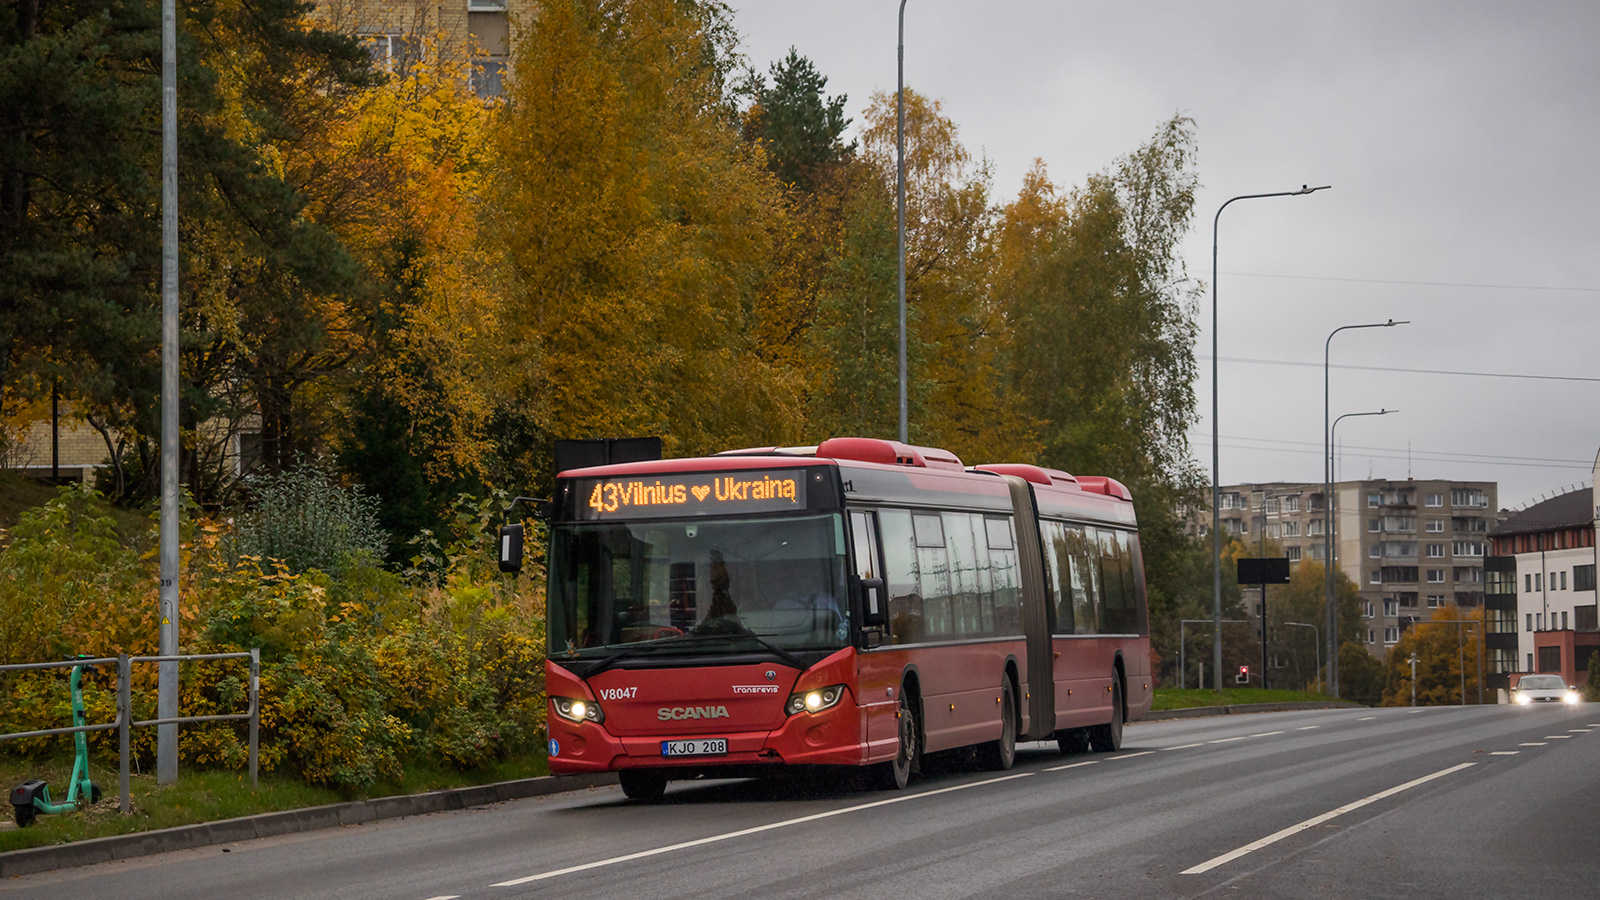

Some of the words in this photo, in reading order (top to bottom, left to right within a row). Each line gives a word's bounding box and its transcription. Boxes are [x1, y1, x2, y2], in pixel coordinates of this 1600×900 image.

[617, 480, 687, 505] Vilnius
[714, 475, 796, 503] Ukrainą
[600, 687, 638, 700] V8047
[657, 706, 730, 721] SCANIA
[669, 743, 695, 754] KJO
[703, 741, 725, 753] 208
